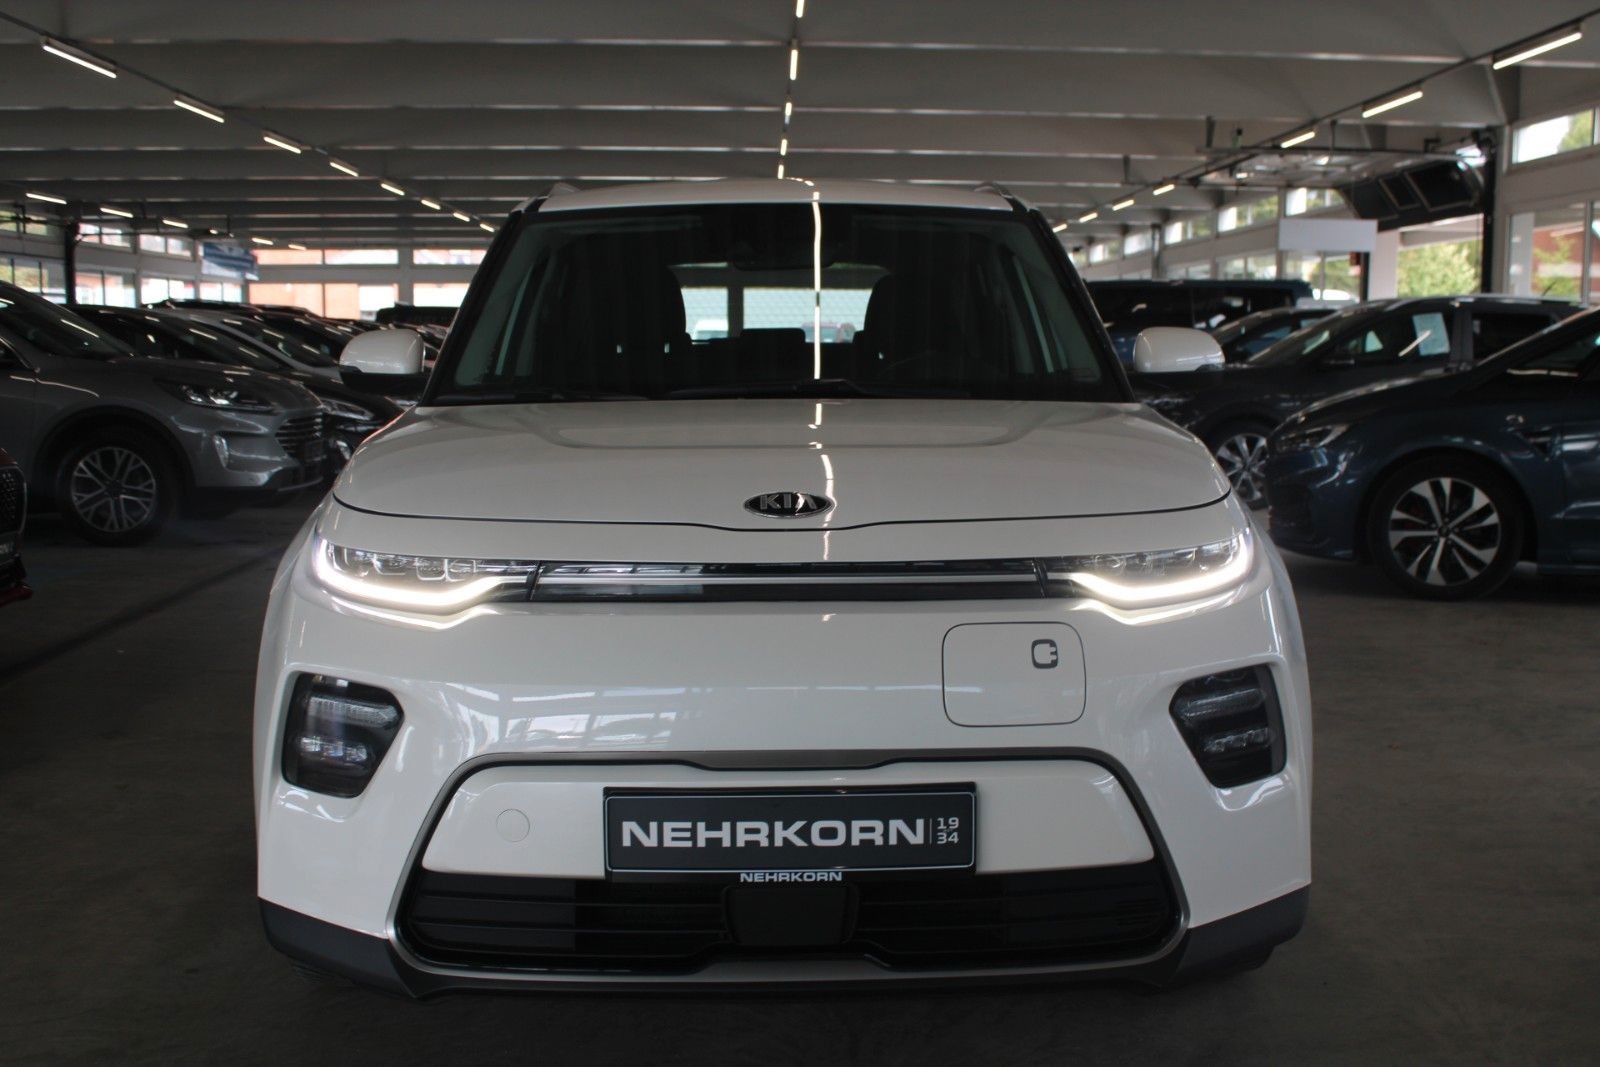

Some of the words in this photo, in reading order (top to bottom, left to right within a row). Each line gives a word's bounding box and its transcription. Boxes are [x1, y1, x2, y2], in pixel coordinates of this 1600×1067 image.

[760, 493, 817, 509] KIA
[937, 817, 960, 829] 19
[622, 818, 924, 847] NEHRKORN
[937, 832, 960, 844] 34
[740, 872, 842, 882] NEHRKORN
